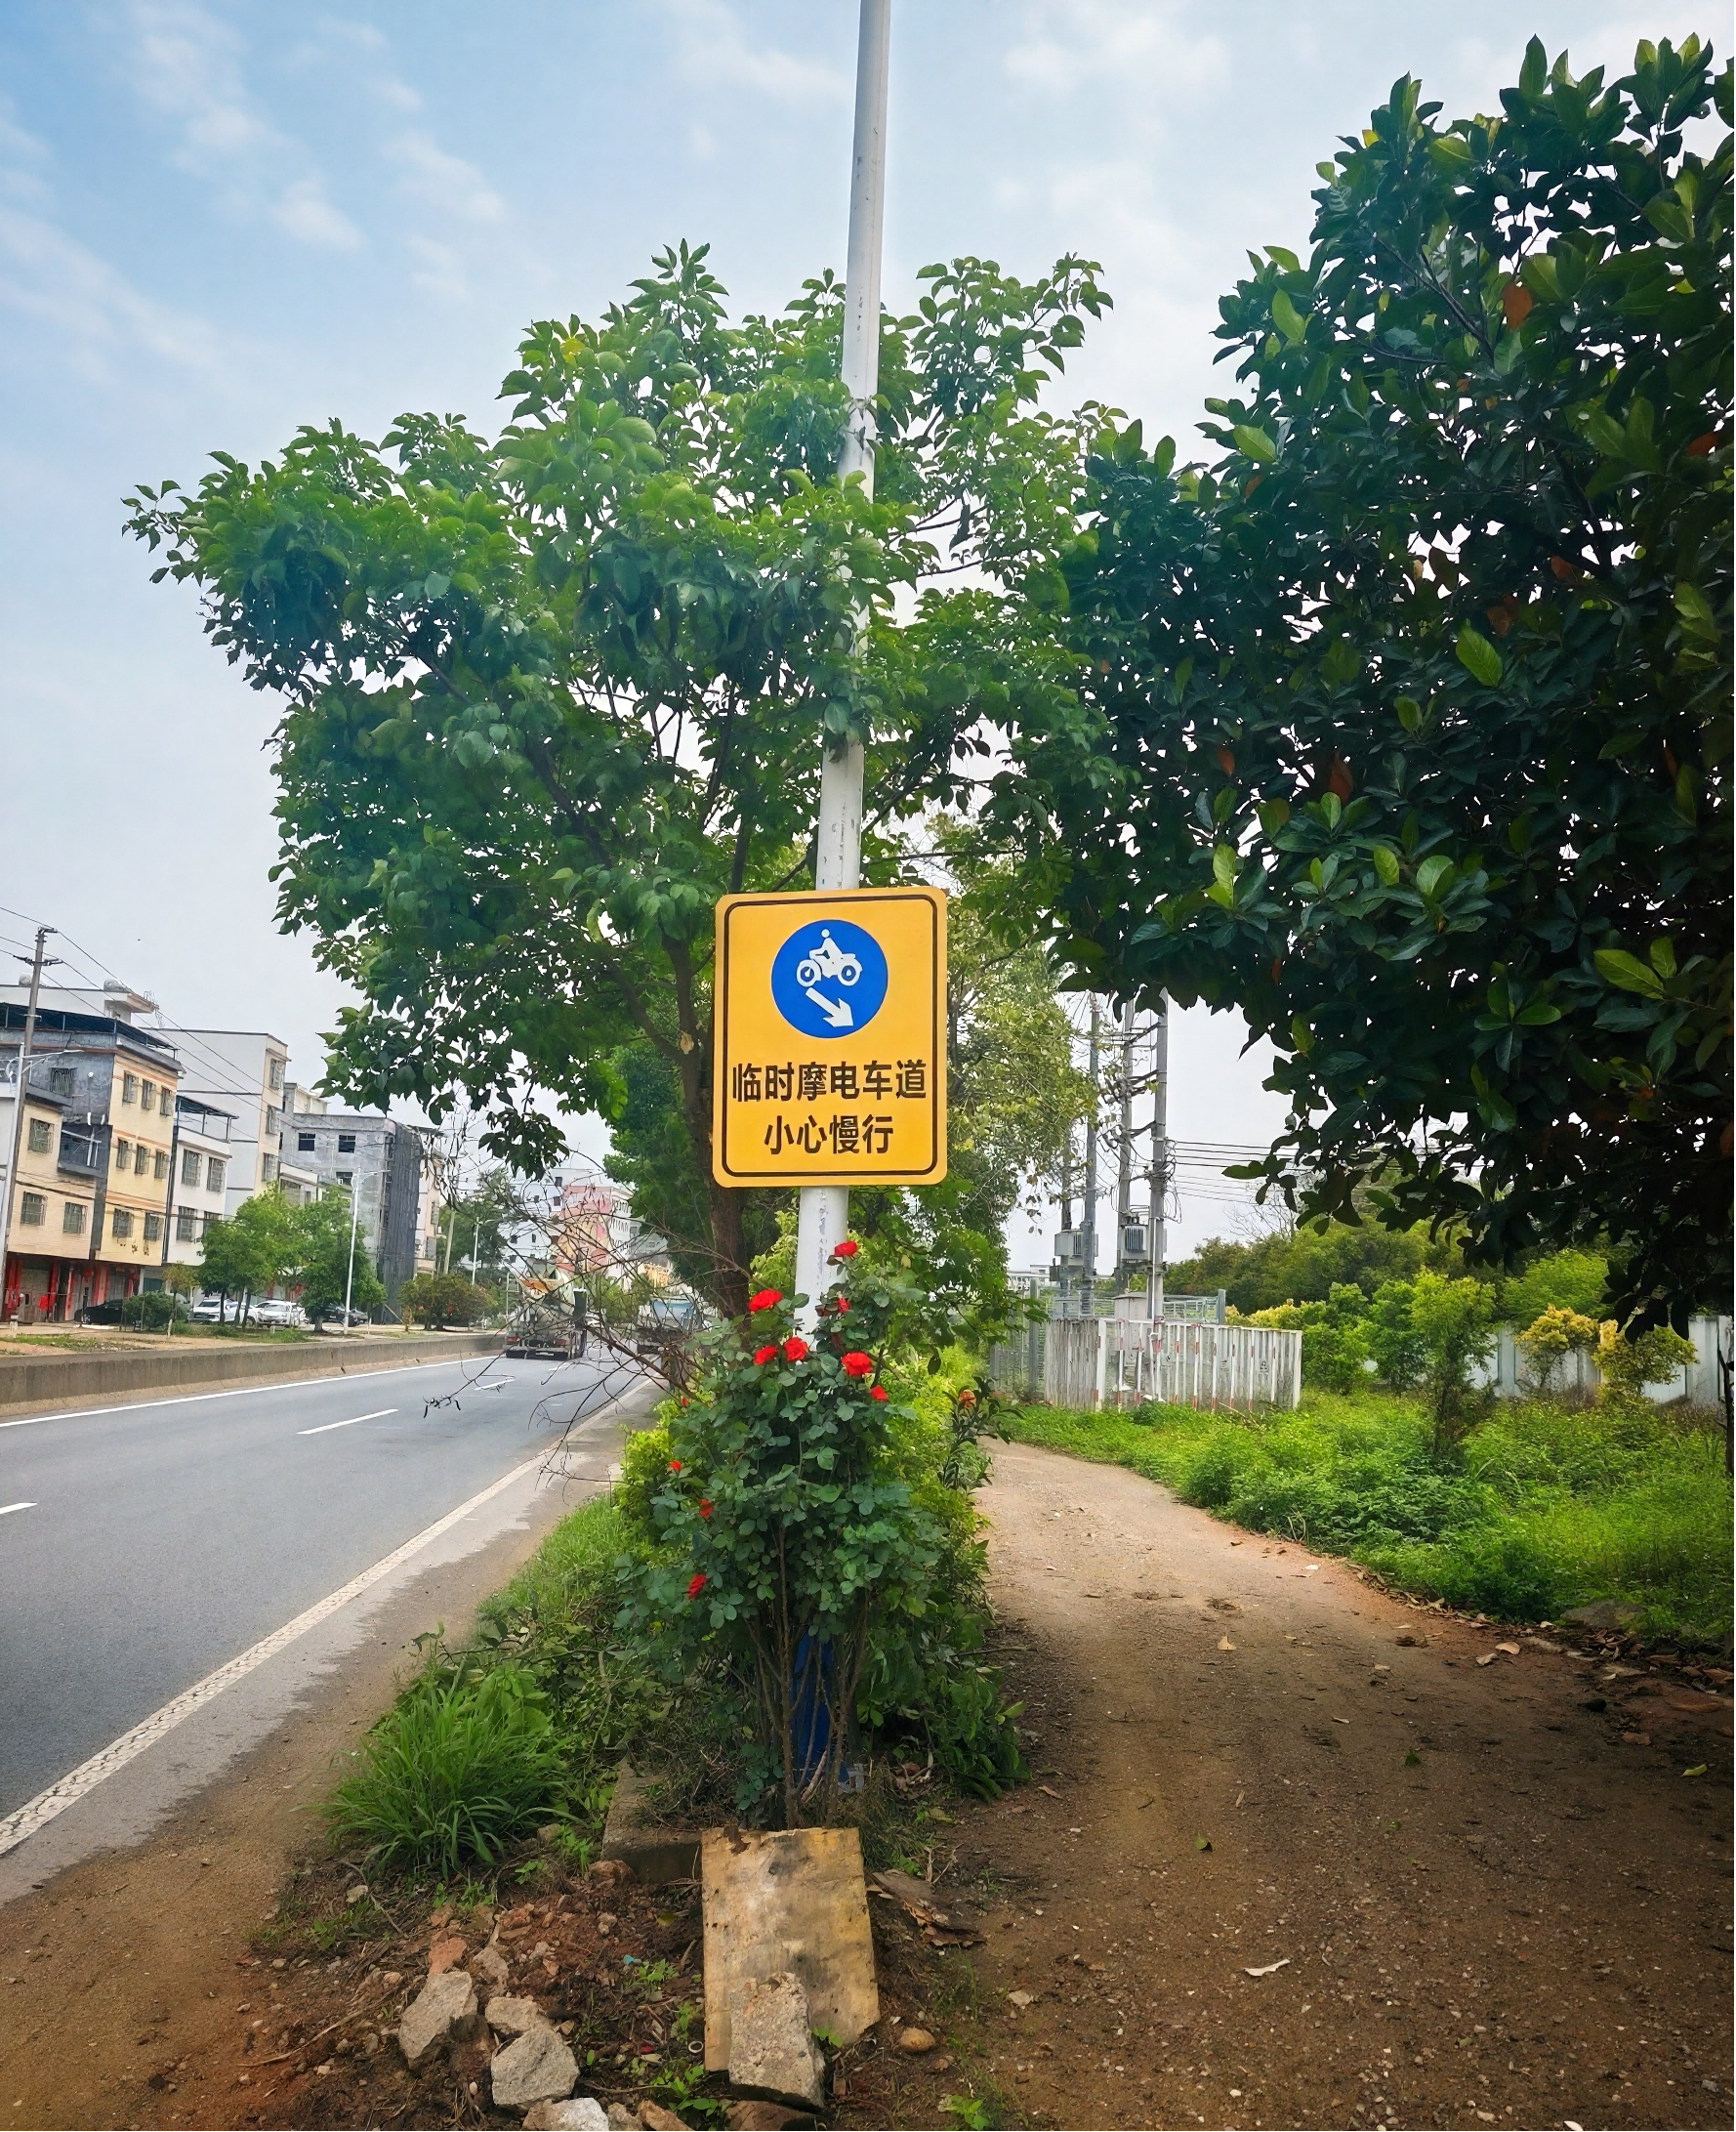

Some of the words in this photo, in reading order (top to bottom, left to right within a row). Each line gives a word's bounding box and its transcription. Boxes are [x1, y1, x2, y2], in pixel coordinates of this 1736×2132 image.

[732, 1059, 927, 1103] 临时摩电车道
[764, 1114, 894, 1154] 小心慢行
